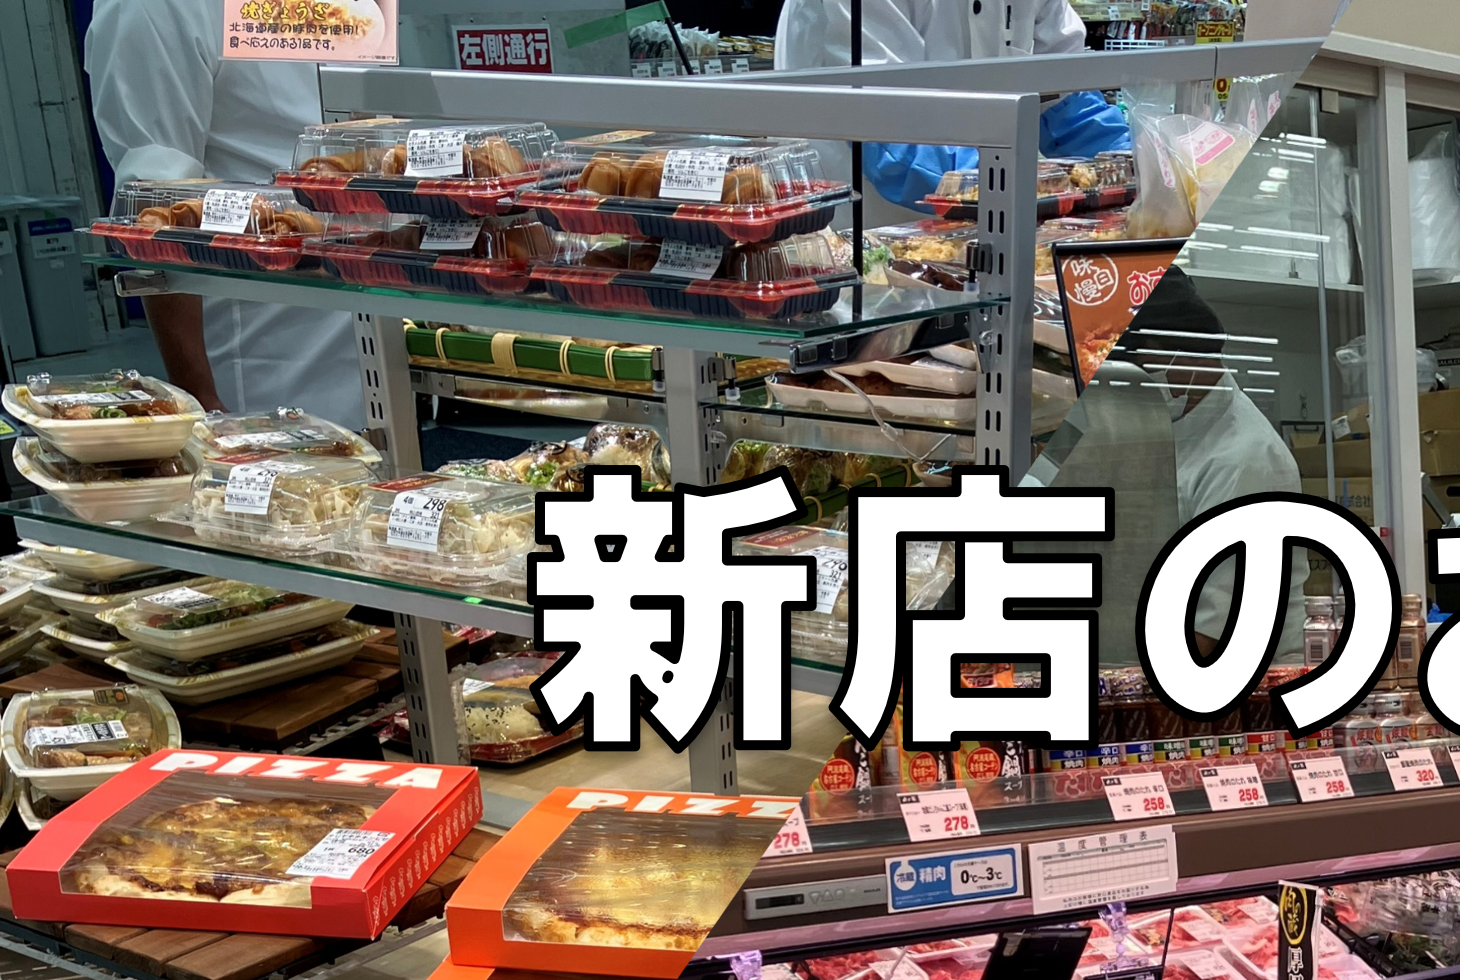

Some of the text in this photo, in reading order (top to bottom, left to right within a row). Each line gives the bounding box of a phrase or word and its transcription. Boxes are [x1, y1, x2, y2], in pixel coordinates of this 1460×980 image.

[461, 32, 548, 67] 左側通行
[423, 498, 447, 512] 298
[150, 753, 444, 789] PIZZA
[1416, 769, 1435, 782] 320
[1325, 780, 1345, 793] 258
[1238, 788, 1259, 801] 258
[1143, 797, 1165, 811] 258
[944, 816, 969, 832] 278
[774, 832, 800, 848] 278
[348, 846, 375, 855] 680
[919, 865, 946, 884] 精肉
